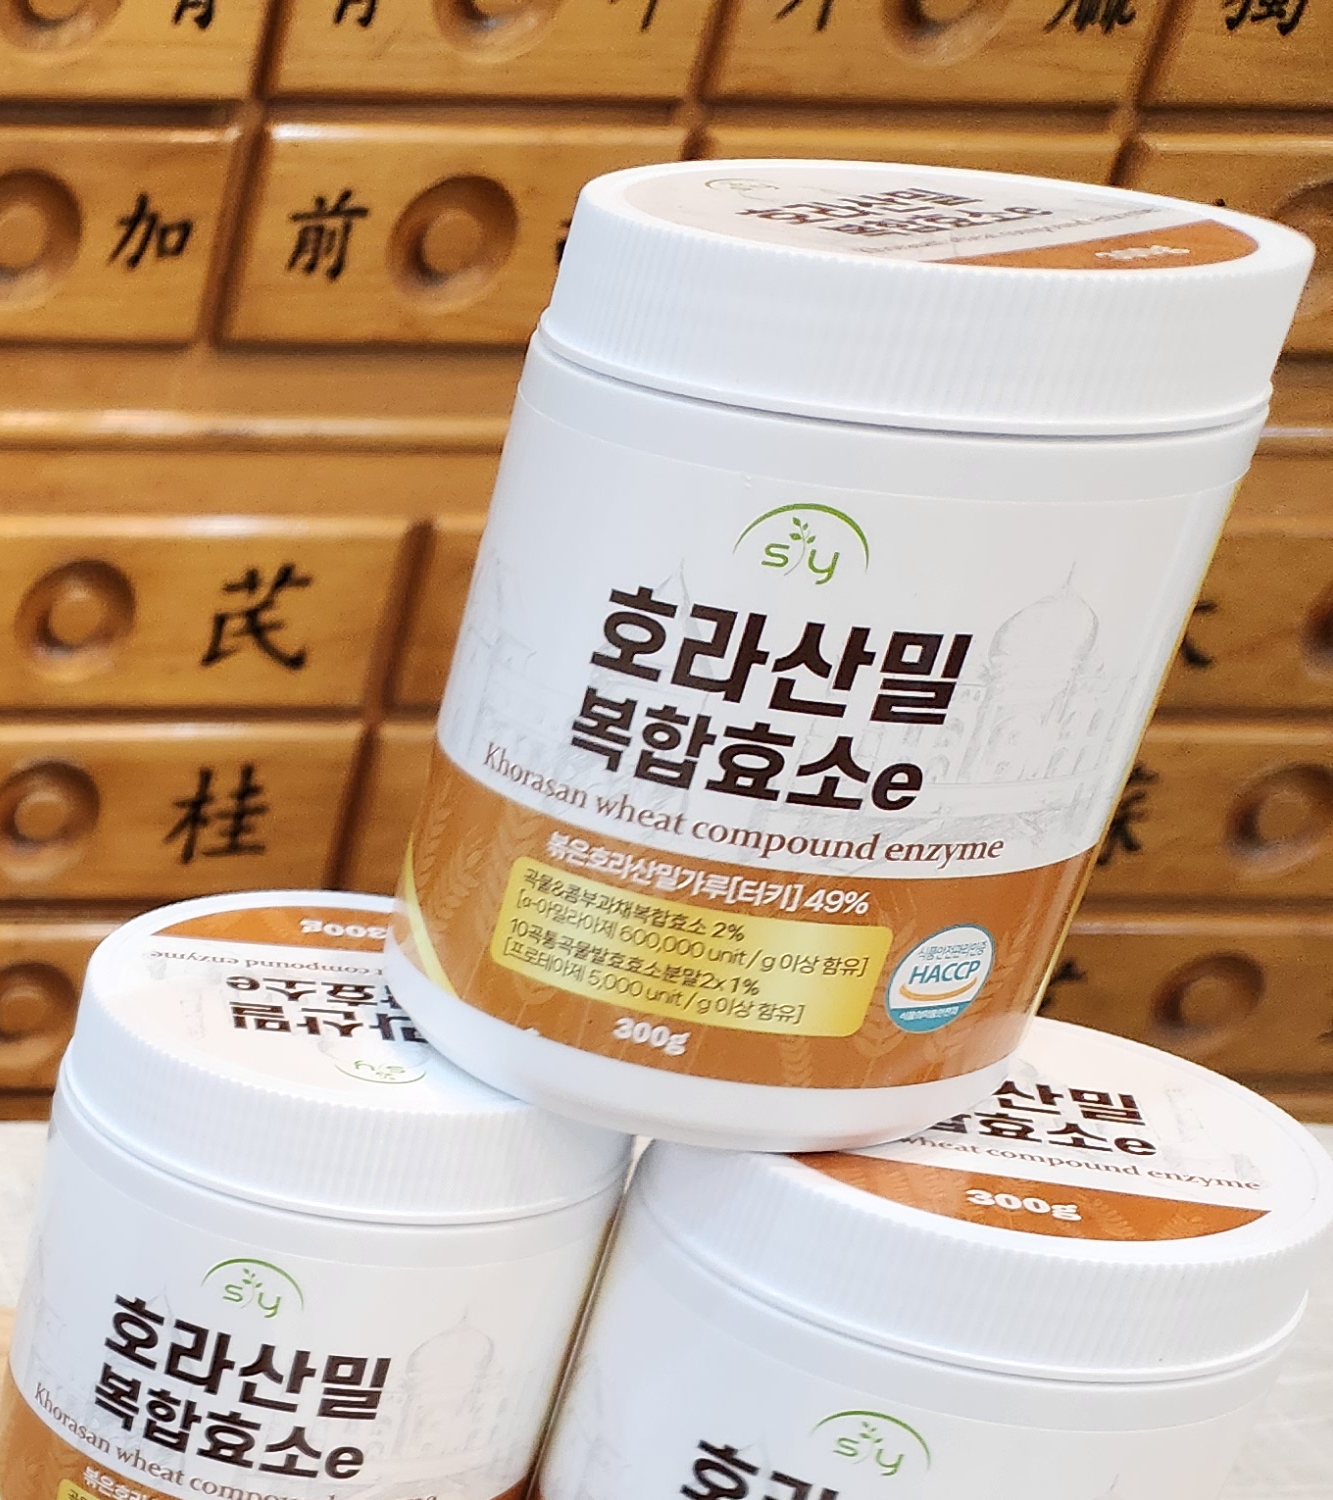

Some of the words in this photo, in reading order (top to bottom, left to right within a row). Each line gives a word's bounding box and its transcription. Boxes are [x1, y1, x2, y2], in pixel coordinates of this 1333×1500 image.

[286, 188, 369, 280] 前
[589, 585, 973, 726] 호라산밀
[570, 686, 924, 812] 복합효소e
[483, 741, 590, 810] Khorasan
[594, 796, 685, 836] wheat
[691, 818, 880, 861] compound
[885, 839, 1004, 869] enzyme
[803, 889, 870, 915] 49%
[619, 925, 706, 958] 600,000
[711, 921, 745, 942] 2%
[245, 958, 371, 976] compound
[907, 959, 981, 985] HACCP
[612, 1017, 691, 1056] 300g
[986, 1146, 1139, 1177] compound
[1147, 1168, 1263, 1191] enzyme
[965, 1188, 1083, 1222] 300g
[104, 1293, 391, 1420] 호라산밀
[34, 1382, 111, 1455] Khorasan
[116, 1444, 184, 1486] wheat
[93, 1362, 365, 1479] 복합효소e
